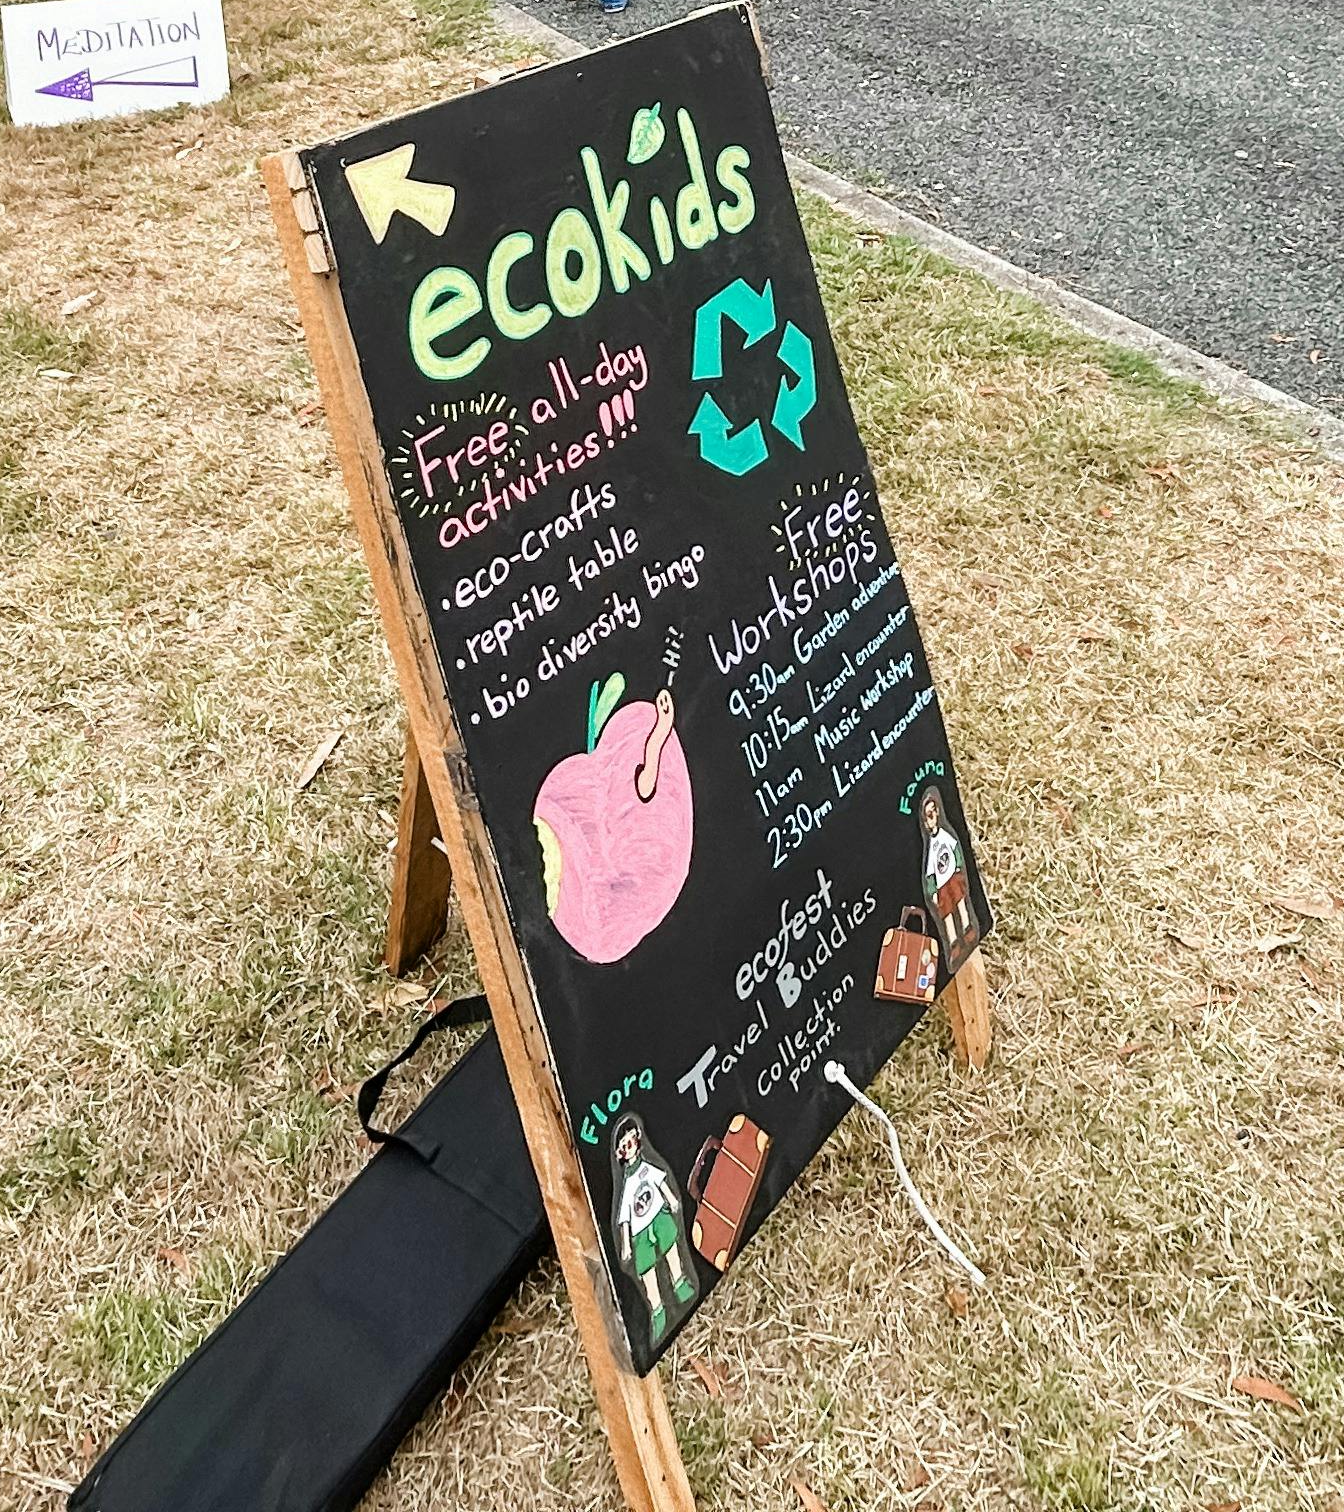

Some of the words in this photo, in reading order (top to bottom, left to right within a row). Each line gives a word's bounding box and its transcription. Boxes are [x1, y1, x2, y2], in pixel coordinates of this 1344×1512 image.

[37, 11, 201, 62] MEDITATION
[408, 105, 757, 381] ecokids
[414, 421, 509, 498] Free
[531, 341, 649, 424] all-day
[438, 388, 638, 549] activities!!!
[784, 488, 863, 561] Free
[466, 584, 560, 664] reptile
[568, 526, 639, 591] table
[482, 673, 530, 719] bio
[537, 592, 642, 682] diversity
[642, 545, 706, 600] bingo
[662, 625, 685, 668] Hi!
[709, 529, 878, 675] Workshops
[793, 610, 851, 664] Garden
[806, 651, 857, 714] Lizard
[855, 605, 910, 666] encounter
[755, 767, 804, 817] 11am
[813, 706, 862, 764] Music
[767, 799, 833, 869] 2:30pm
[832, 729, 884, 798] Lizard
[882, 685, 935, 751] encounter
[898, 759, 945, 815] Fauna
[676, 1000, 770, 1109] Travel
[775, 887, 878, 1009] Buddies
[735, 868, 835, 1000] ecofest
[579, 1067, 654, 1145] Flora
